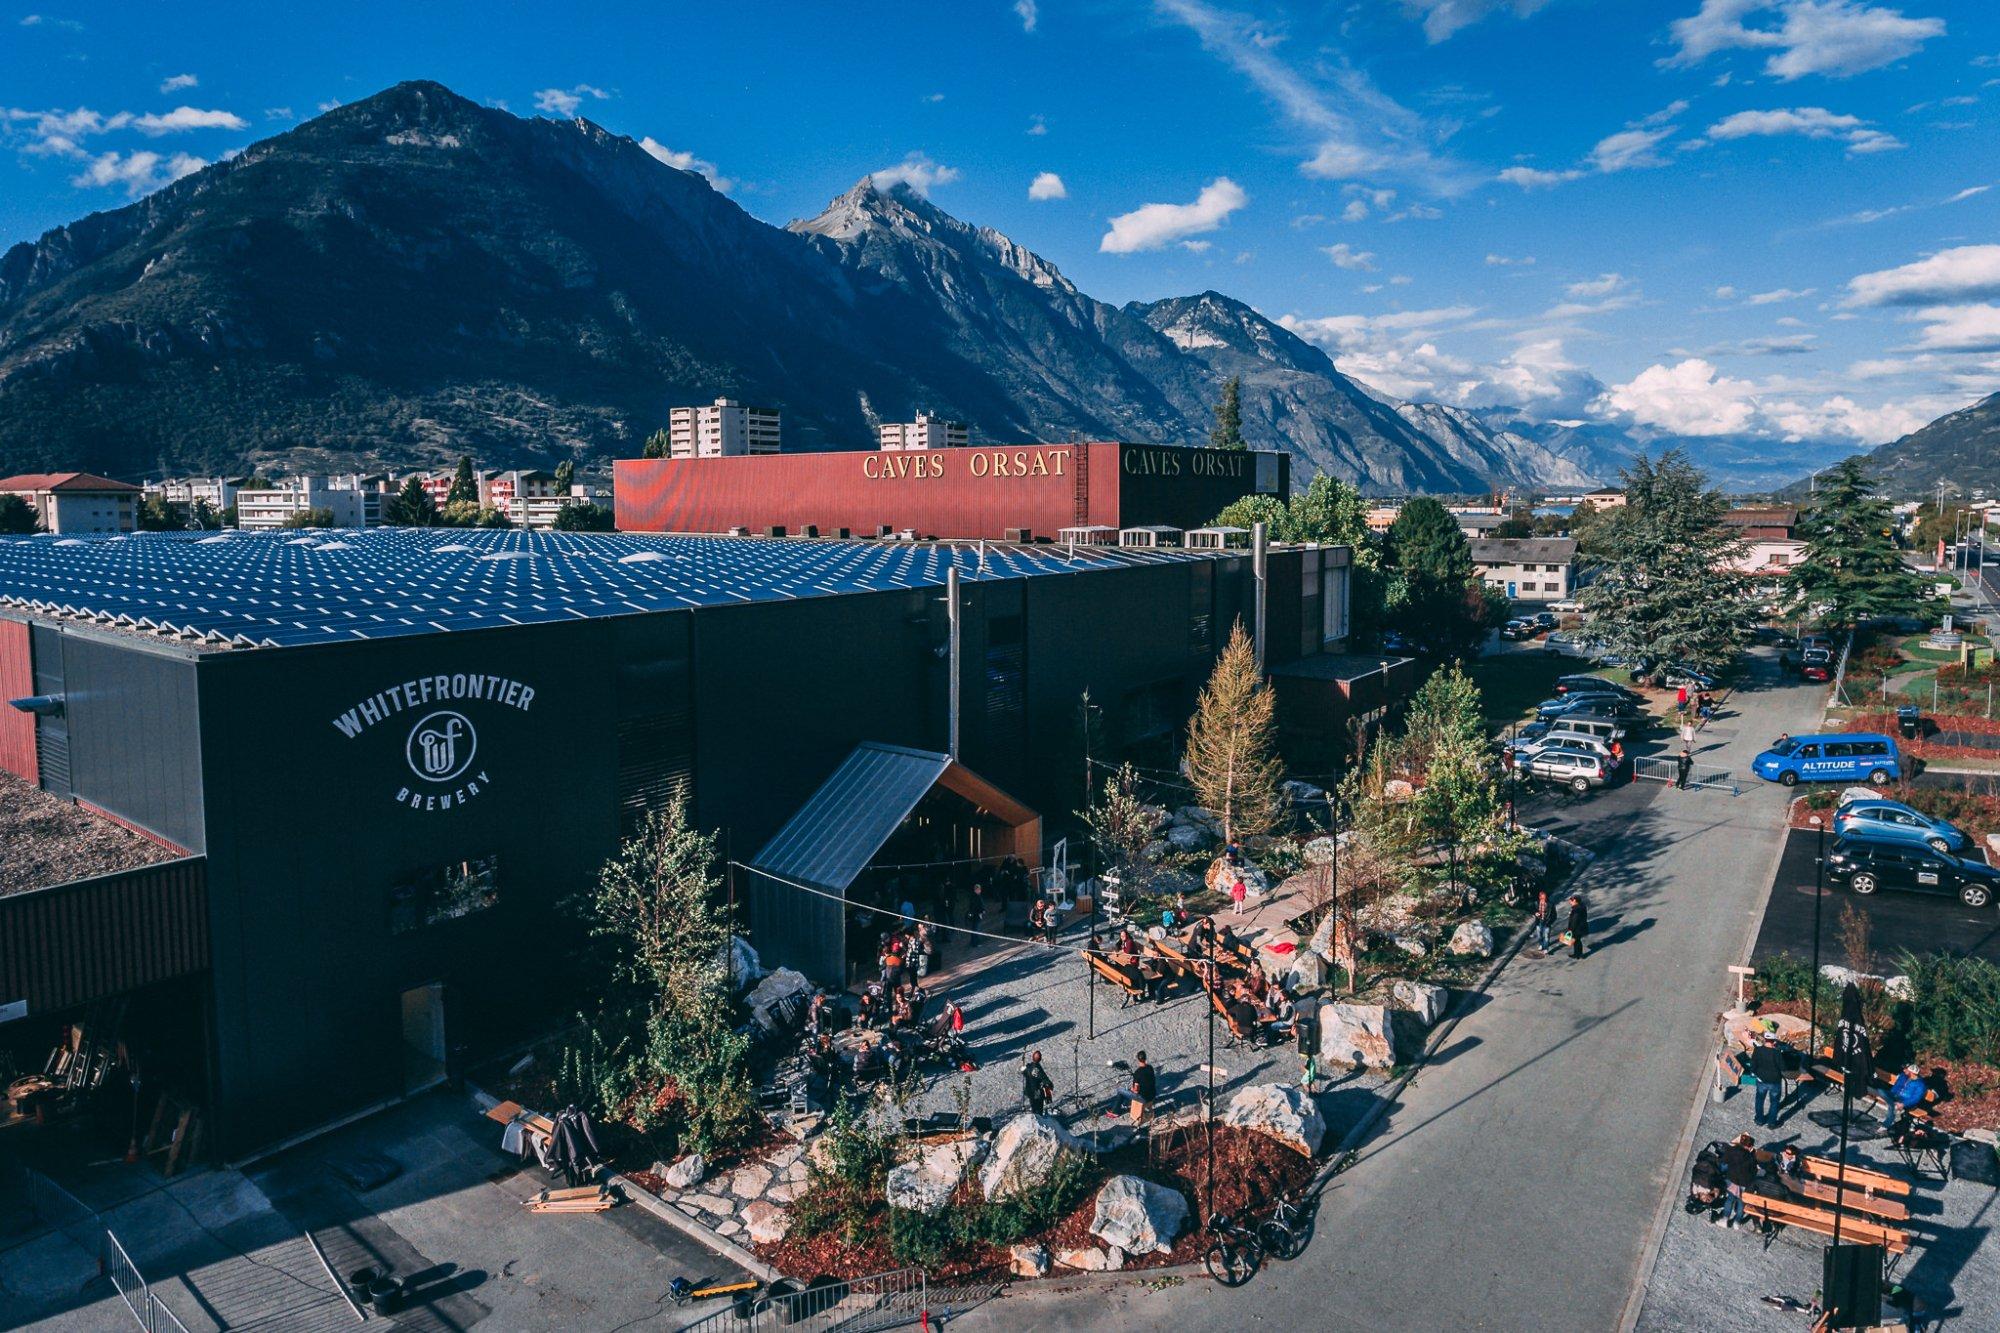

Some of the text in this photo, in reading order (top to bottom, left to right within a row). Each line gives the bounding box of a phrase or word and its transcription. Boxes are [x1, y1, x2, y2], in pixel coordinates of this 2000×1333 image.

[863, 450, 1071, 479] CAVES ORSAT
[1124, 449, 1245, 477] CAVES ORSAT
[332, 673, 536, 739] WHITEFRONTIER
[1802, 760, 1856, 770] ALTITUDE
[396, 770, 490, 811] BREWERY
